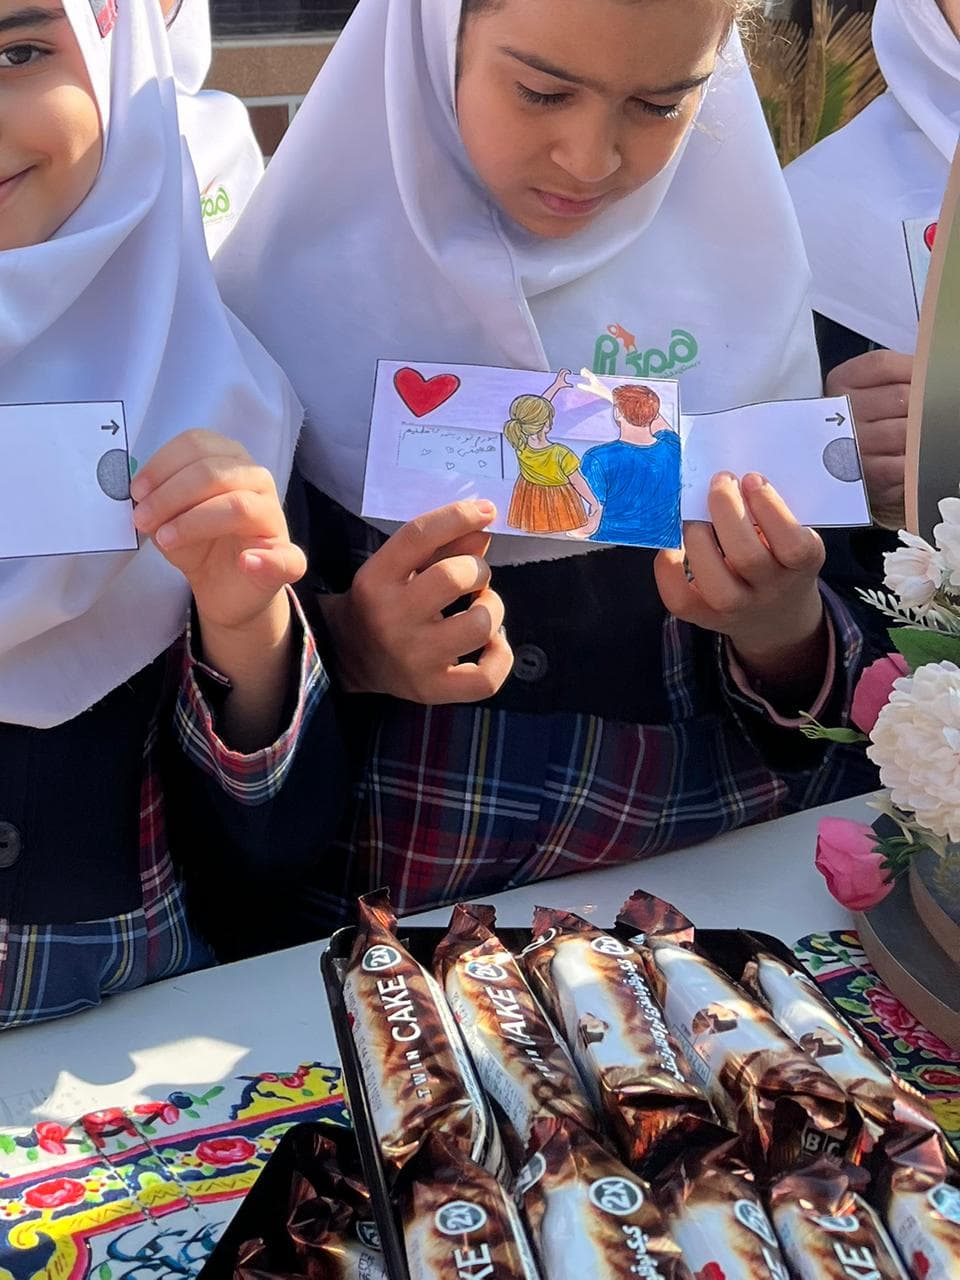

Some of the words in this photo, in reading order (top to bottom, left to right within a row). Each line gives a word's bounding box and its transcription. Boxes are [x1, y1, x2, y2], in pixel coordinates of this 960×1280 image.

[376, 974, 422, 1042] CAKE
[484, 985, 537, 1046] AKE
[406, 1050, 432, 1100] TWIN
[453, 1242, 494, 1280] KE
[833, 1241, 881, 1280] KE
